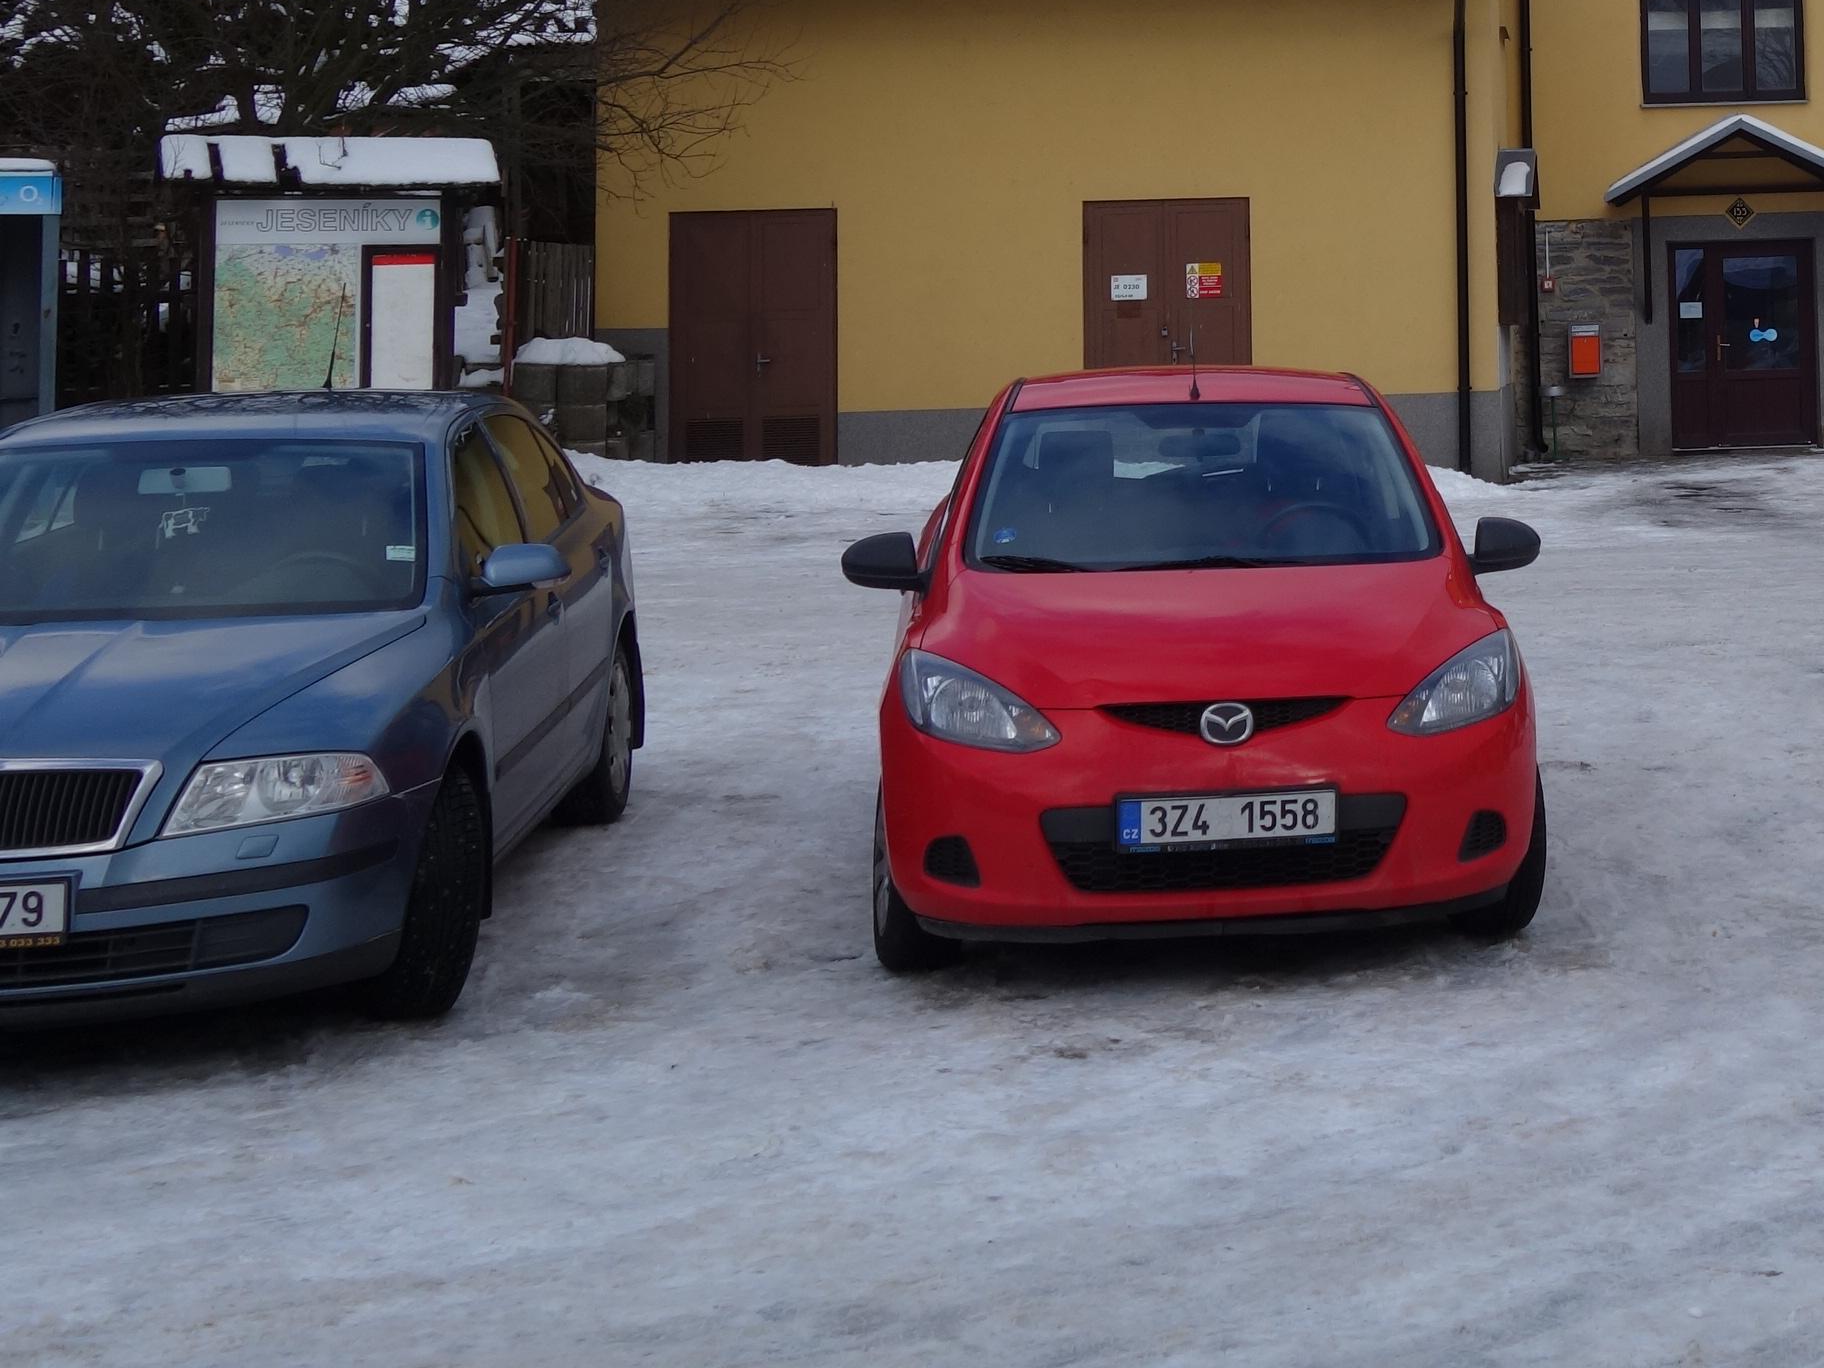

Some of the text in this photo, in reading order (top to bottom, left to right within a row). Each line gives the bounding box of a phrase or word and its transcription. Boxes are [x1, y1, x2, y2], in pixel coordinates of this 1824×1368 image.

[255, 202, 413, 233] JESENÍKY
[1149, 798, 1320, 838] 3Z4 1558
[1122, 828, 1139, 840] CZ
